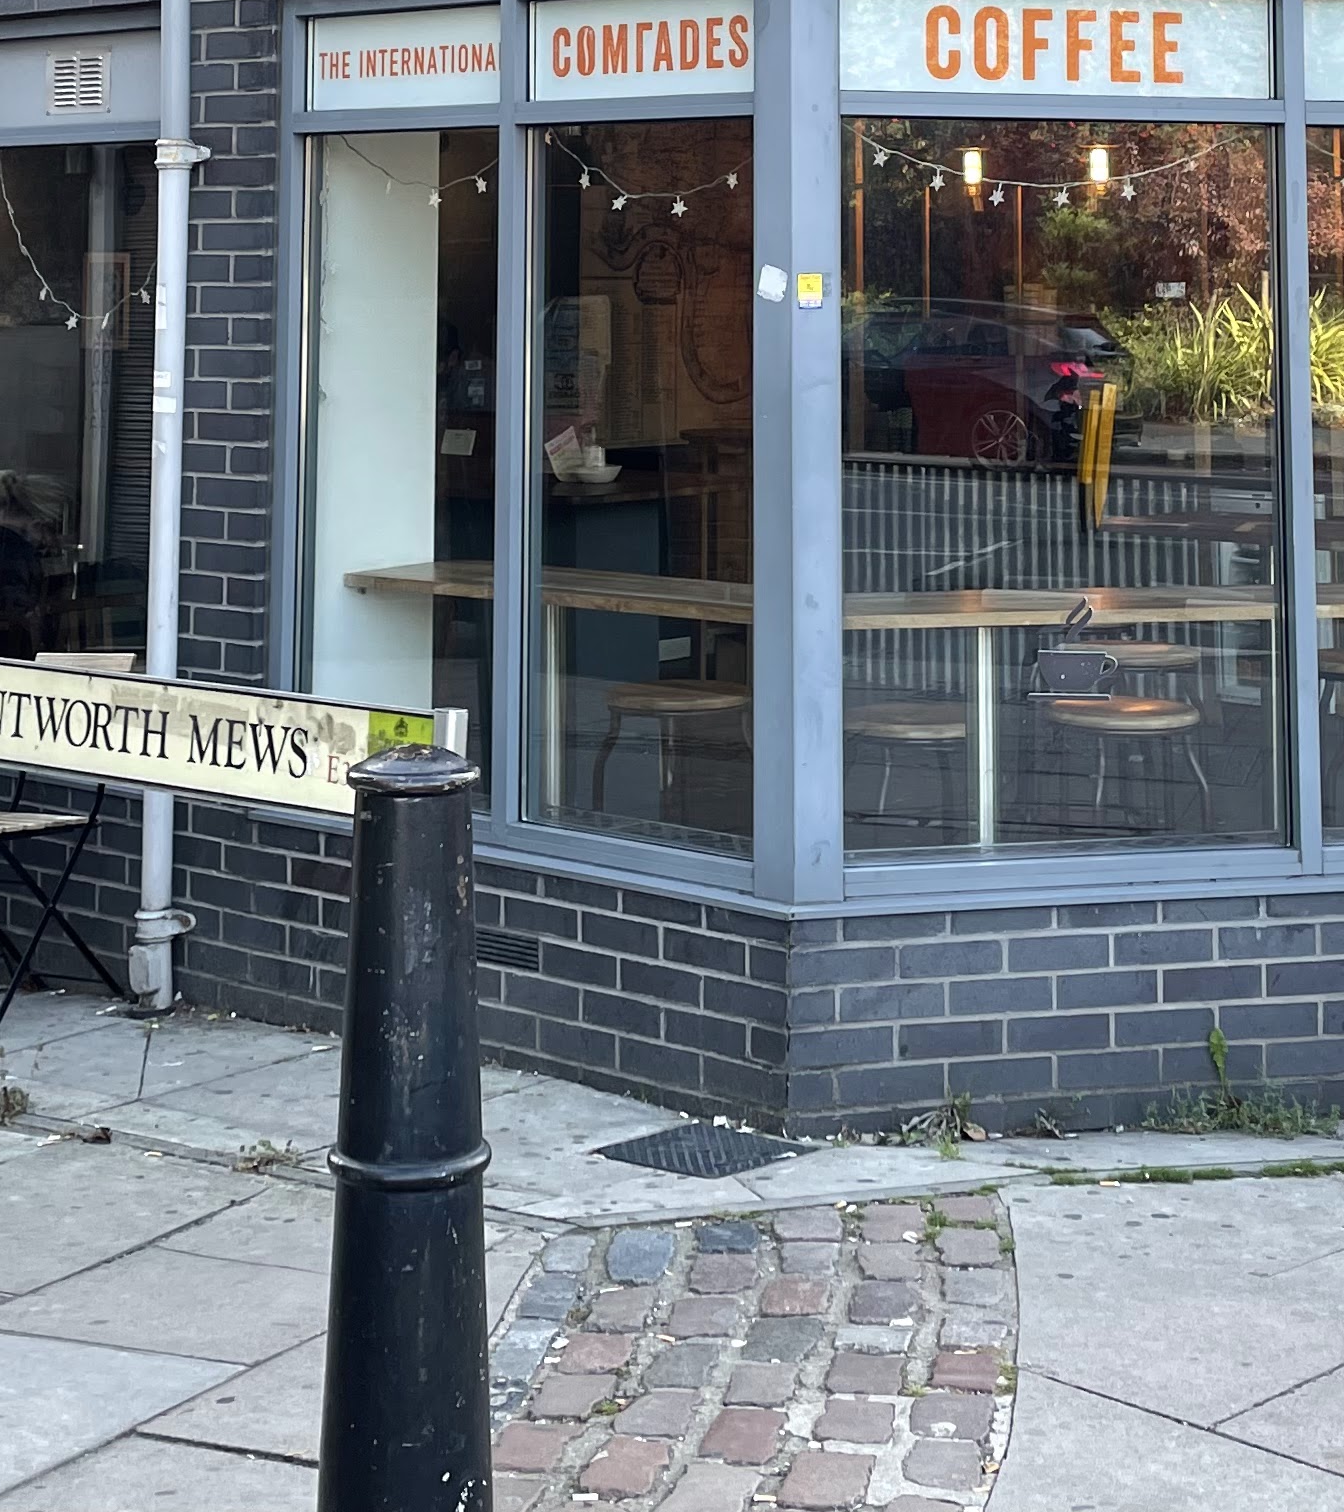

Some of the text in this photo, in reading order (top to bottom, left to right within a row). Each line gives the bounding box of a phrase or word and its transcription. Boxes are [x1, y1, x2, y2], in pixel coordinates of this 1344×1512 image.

[318, 40, 503, 81] THE INTERNATIONA
[924, 4, 1184, 85] COFFEE
[186, 713, 309, 780] MEWS
